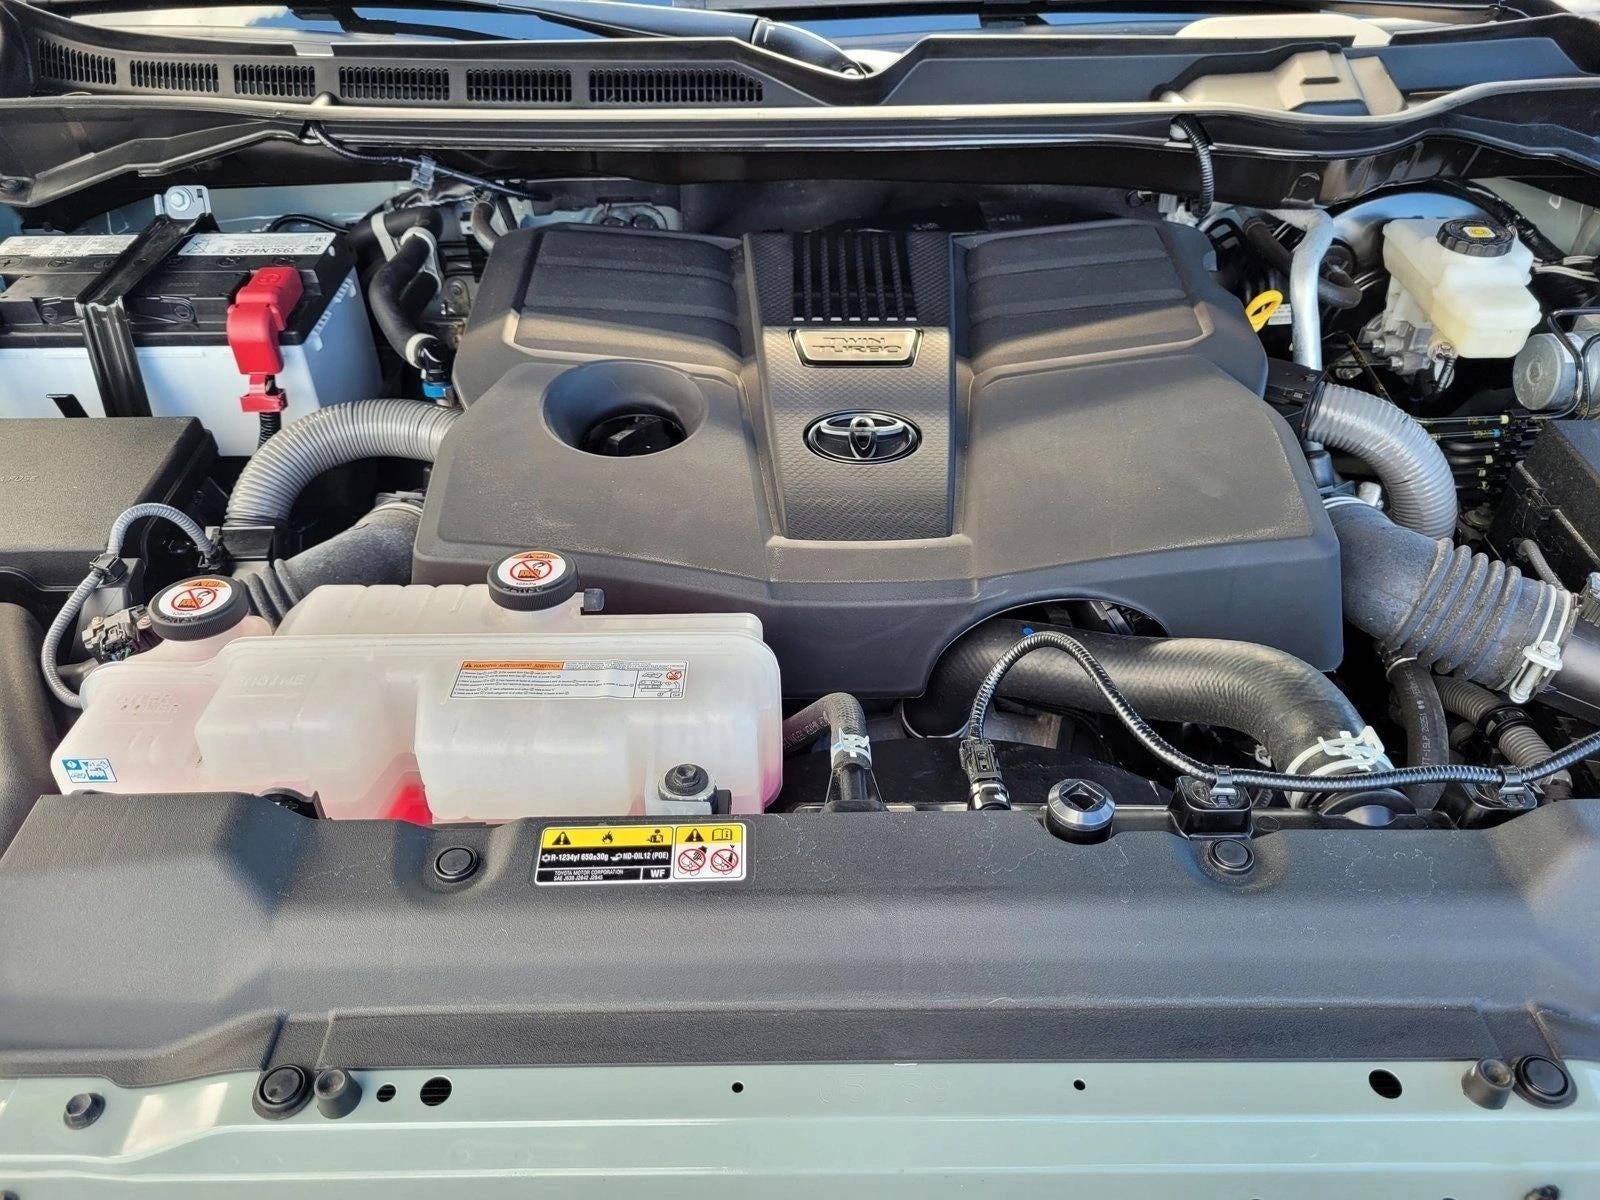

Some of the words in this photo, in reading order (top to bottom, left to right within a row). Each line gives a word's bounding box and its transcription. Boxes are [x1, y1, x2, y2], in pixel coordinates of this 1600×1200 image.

[812, 345, 903, 353] TURBO
[550, 853, 580, 863] R-1234yf
[581, 852, 609, 862] 650±30g
[652, 851, 669, 860] (POE)
[649, 869, 666, 878] WF
